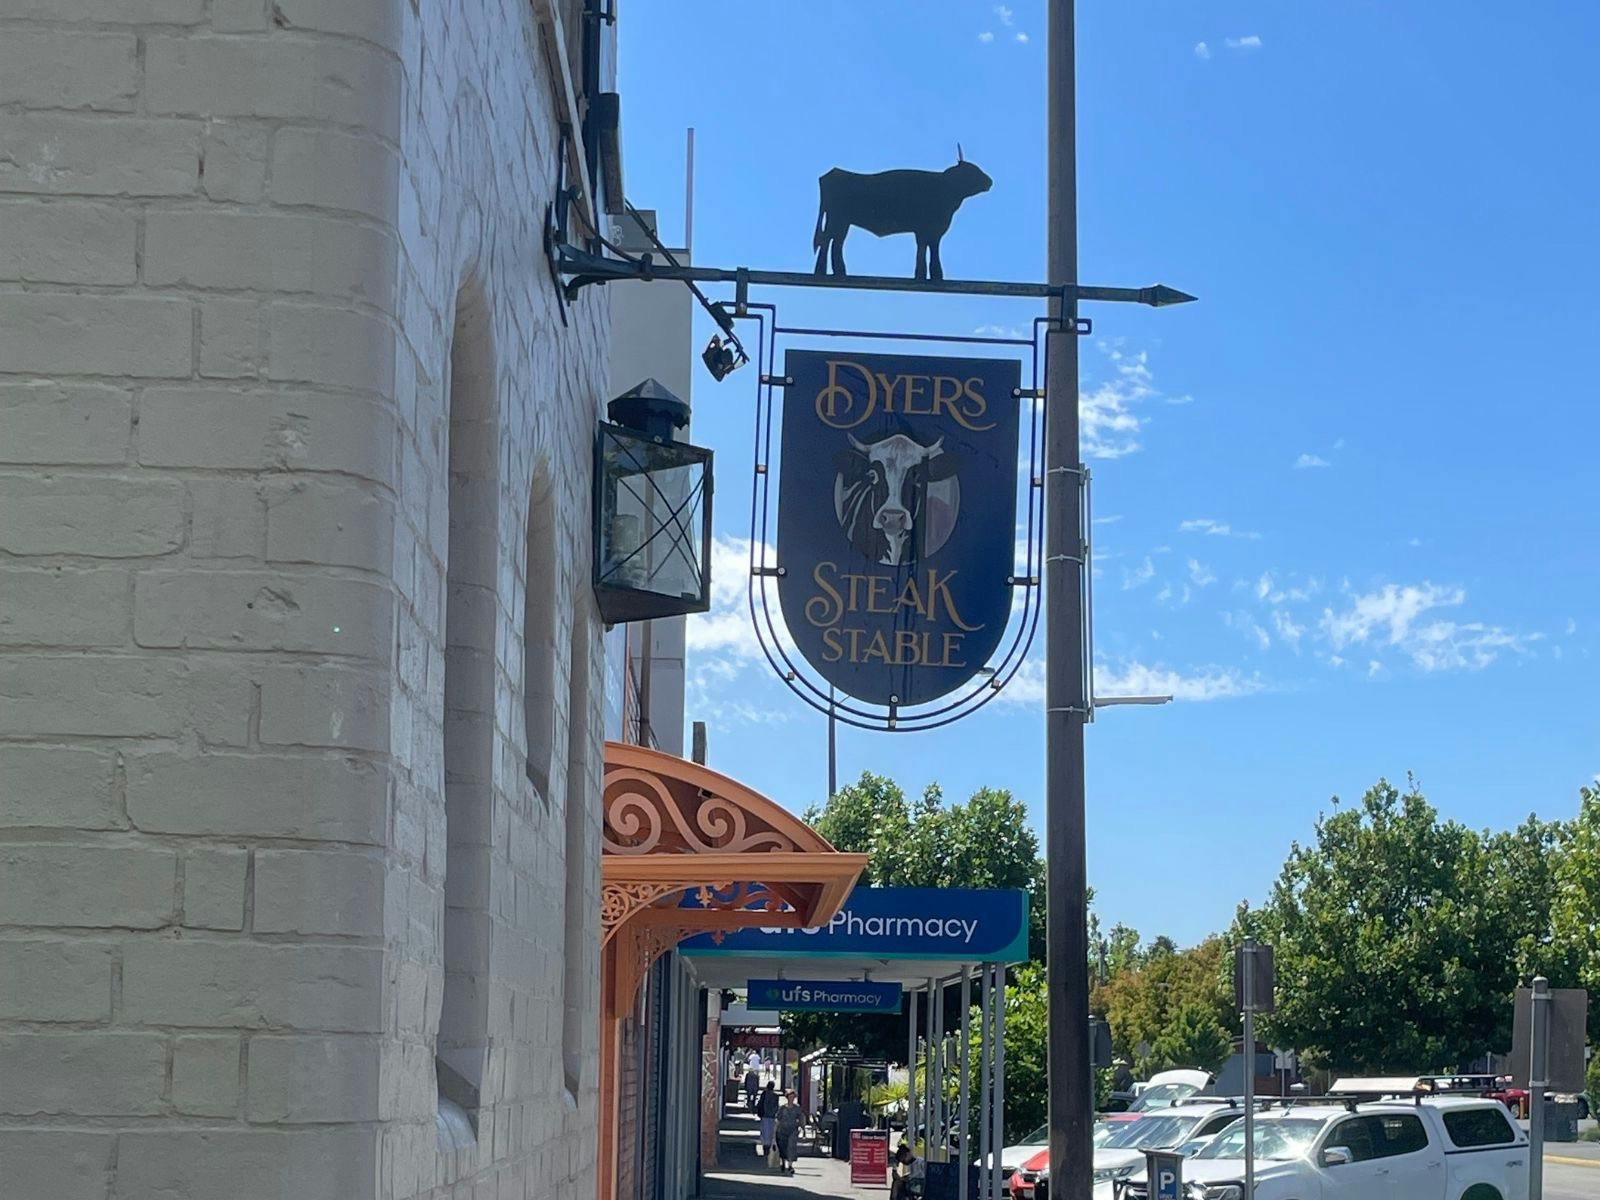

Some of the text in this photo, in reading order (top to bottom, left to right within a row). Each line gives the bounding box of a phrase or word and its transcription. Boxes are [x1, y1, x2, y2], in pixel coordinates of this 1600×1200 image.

[815, 360, 997, 430] DYERS
[805, 561, 986, 632] STEAK
[821, 628, 967, 668] STABLE
[829, 910, 978, 943] Pharmacy
[782, 985, 882, 1006] ufs Pharmacy
[1160, 1171, 1175, 1190] P
